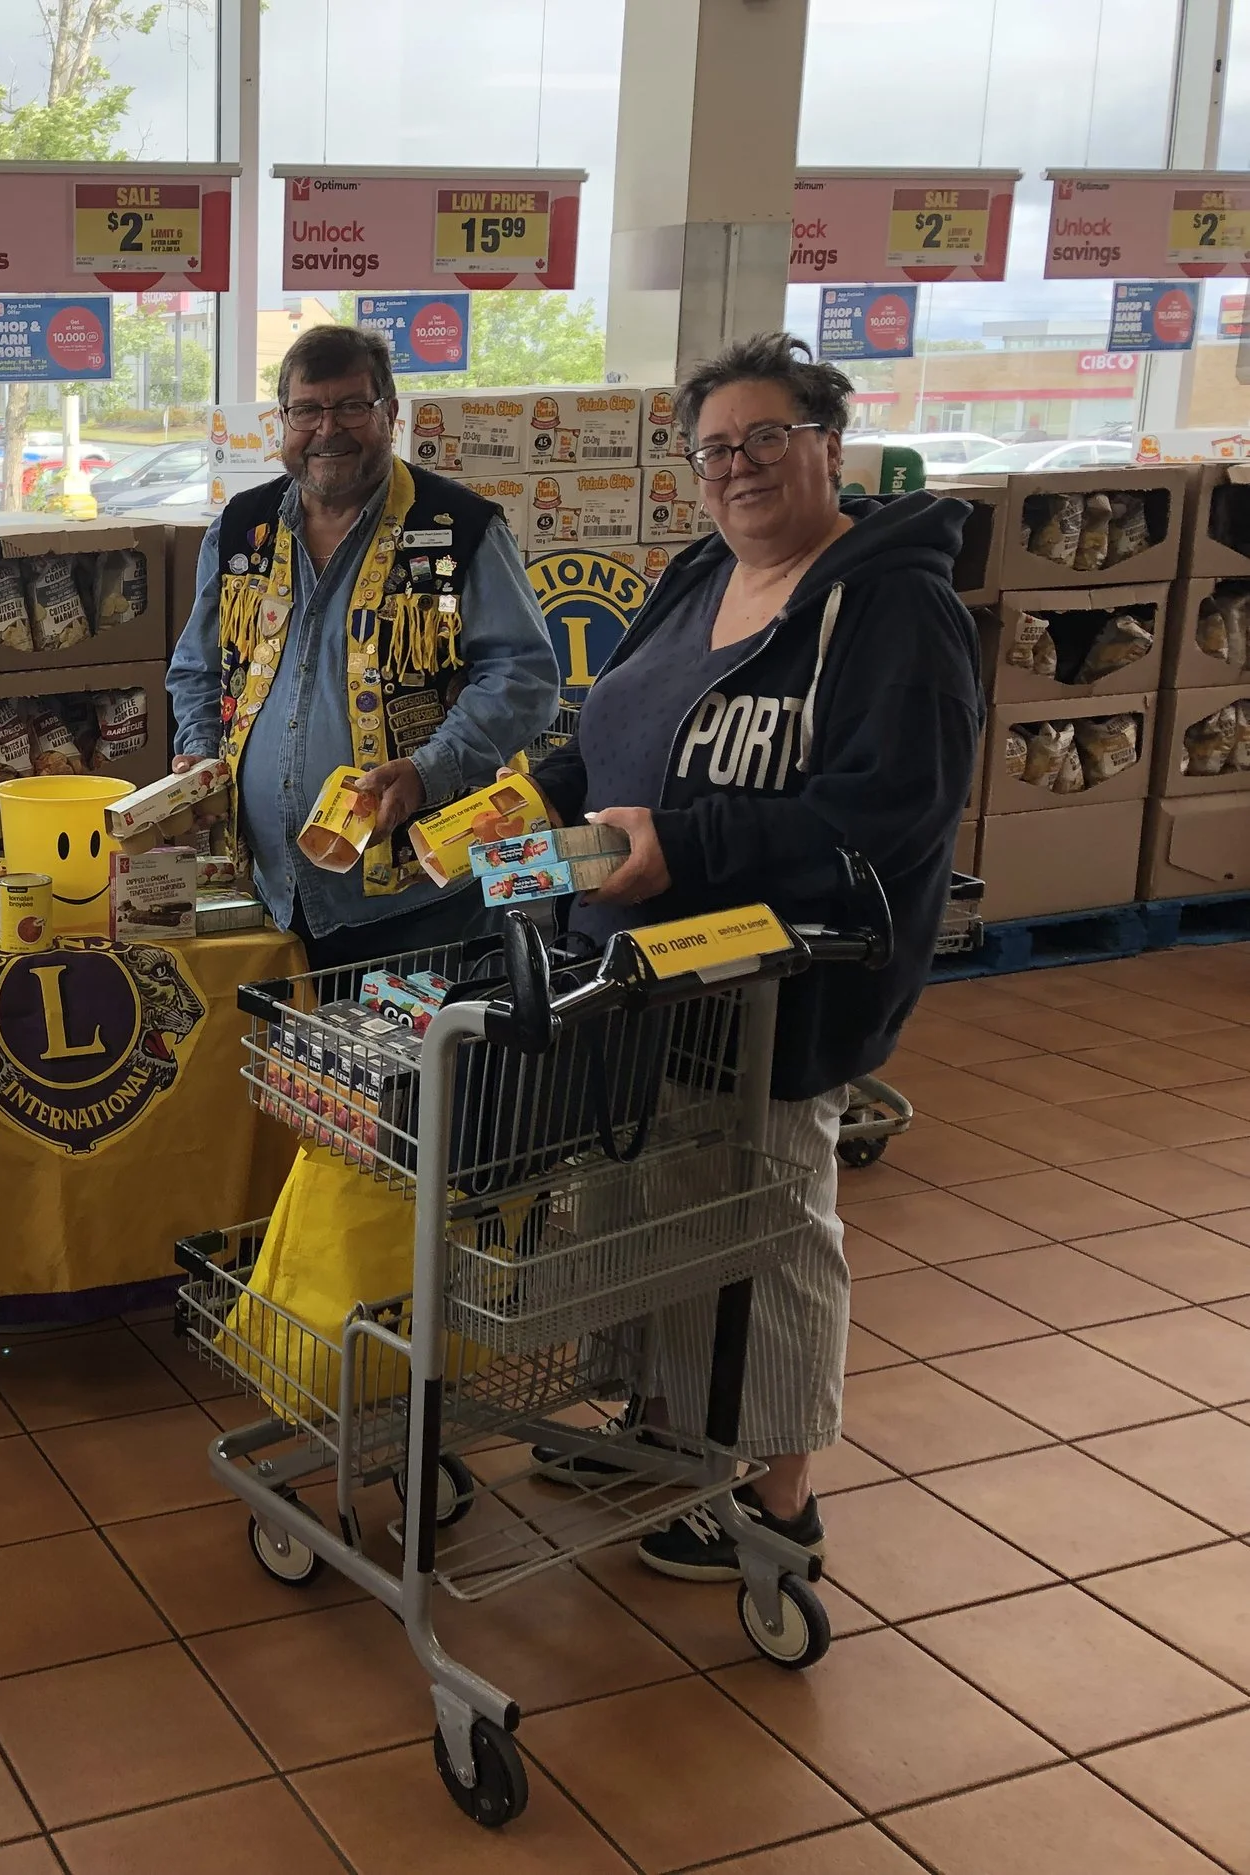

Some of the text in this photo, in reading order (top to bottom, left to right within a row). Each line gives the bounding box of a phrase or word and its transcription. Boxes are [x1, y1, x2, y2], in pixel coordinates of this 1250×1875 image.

[313, 179, 358, 192] Optimum
[116, 186, 160, 207] SALE
[452, 192, 536, 212] LOW PRICE
[925, 191, 959, 208] SALE
[151, 228, 183, 239] LIMIT 6
[291, 220, 365, 243] Unlock
[792, 218, 828, 239] lock
[1056, 216, 1112, 237] Unlock
[790, 243, 838, 271] vings
[1052, 241, 1121, 267] savings
[291, 247, 379, 278] savings
[824, 307, 862, 318] SHOP &
[1116, 301, 1142, 311] SHOP
[361, 317, 406, 329] SHOP &
[823, 319, 851, 329] EARN
[870, 316, 896, 327] 10,000
[1115, 312, 1141, 322] EARN
[29, 321, 41, 332] &
[415, 328, 447, 338] 10,000
[53, 332, 86, 343] 10,000
[822, 329, 853, 340] MORE
[1081, 355, 1117, 370] CIBC
[462, 401, 524, 417] Potato Chips
[536, 401, 549, 410] Old
[577, 395, 635, 412] Potato Chips
[419, 406, 433, 416] Old
[536, 408, 556, 418] Dutch
[419, 415, 440, 425] Dutch
[537, 438, 548, 447] 45
[654, 432, 665, 442] 45
[421, 446, 433, 455] 45
[497, 481, 524, 497] Chips
[577, 473, 635, 491] Potato Chips
[654, 481, 674, 491] Dutch
[538, 488, 557, 498] Dutch
[540, 517, 551, 526] 45
[655, 510, 666, 519] 45
[50, 602, 72, 617] CUITES
[53, 609, 80, 625] MARMITE
[114, 699, 136, 715] KETTLE
[113, 707, 139, 724] COOKED
[106, 721, 145, 736] BARBECUE
[0, 741, 22, 755] CUITES
[426, 812, 458, 831] mandarin
[457, 800, 484, 817] oranges
[717, 917, 770, 936] saving simple
[648, 932, 708, 956] no name
[29, 964, 106, 1060] L
[1, 1064, 152, 1131] INTERNATIONAL
